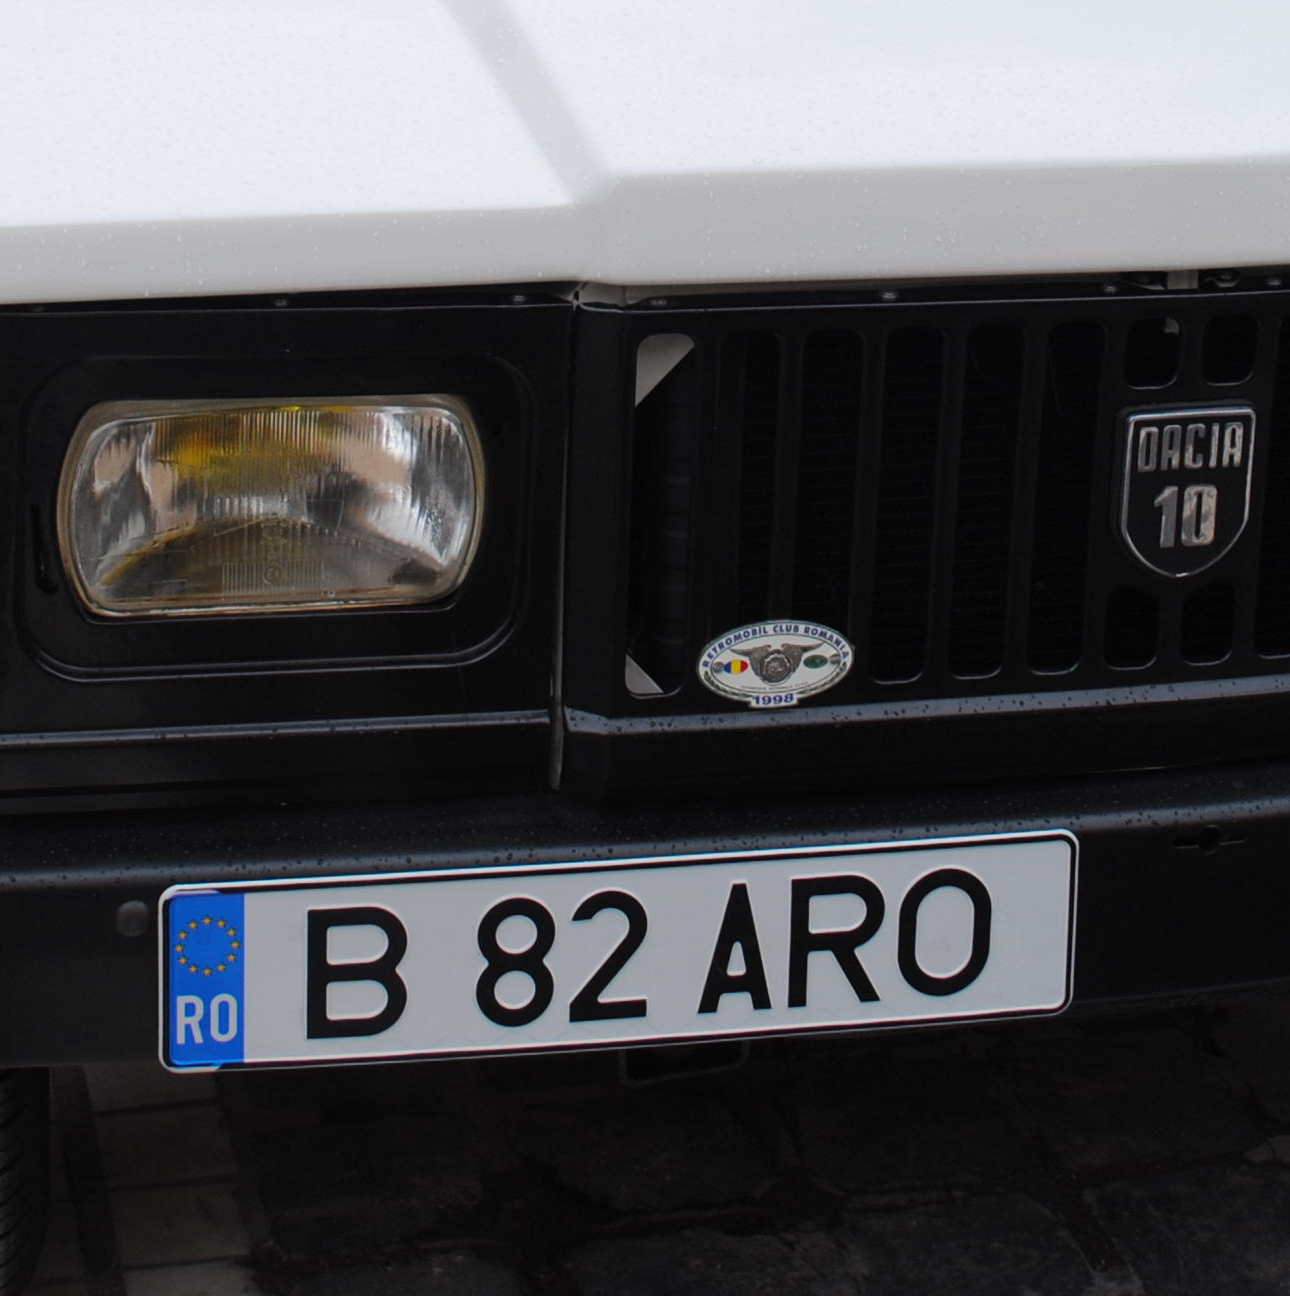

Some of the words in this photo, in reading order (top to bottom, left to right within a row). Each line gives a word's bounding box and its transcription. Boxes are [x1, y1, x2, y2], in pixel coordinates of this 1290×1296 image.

[1137, 421, 1244, 473] DACIA
[1153, 483, 1218, 549] 10
[772, 623, 800, 634] CLUB
[752, 692, 796, 705] 1998
[306, 905, 408, 1040] B
[474, 889, 650, 1029] 82
[697, 866, 994, 1015] ARO
[175, 994, 239, 1045] RO
